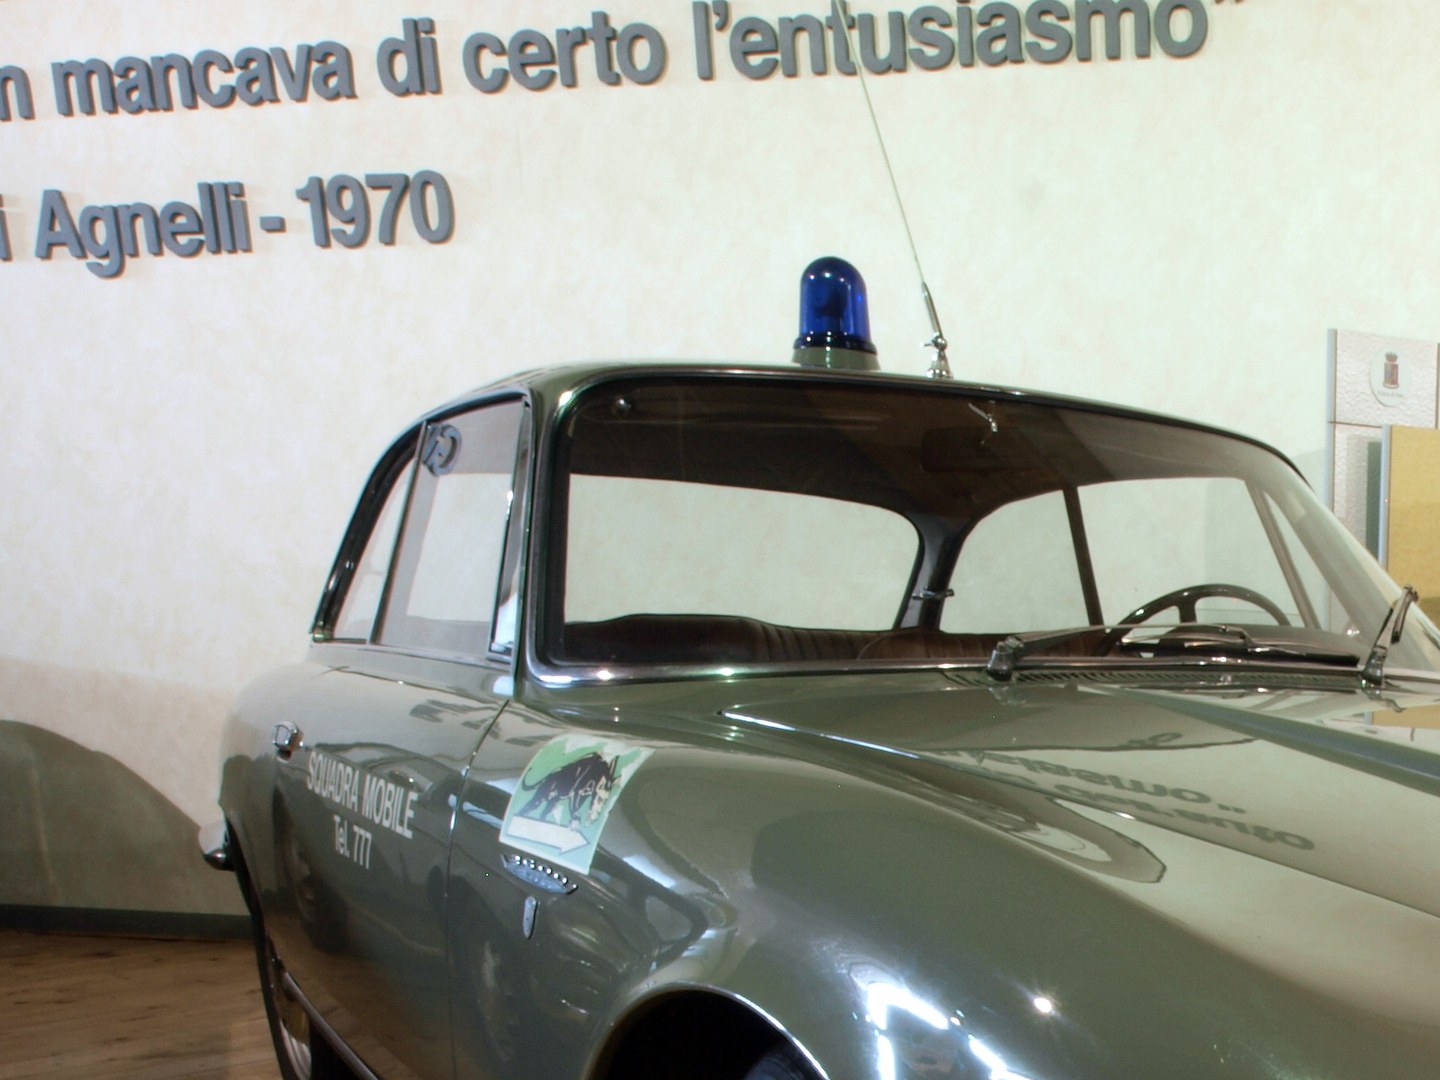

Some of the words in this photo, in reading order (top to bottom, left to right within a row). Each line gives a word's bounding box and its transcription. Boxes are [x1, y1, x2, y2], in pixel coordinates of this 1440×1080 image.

[51, 39, 357, 117] mancava
[376, 17, 441, 98] di
[462, 11, 668, 92] certo
[692, 0, 1246, 81] l'entusiasmo
[35, 181, 253, 279] Agnelli
[295, 170, 456, 248] 1970
[306, 750, 360, 813] SQUADRA
[361, 773, 419, 839] MOBILE
[352, 824, 372, 870] 777
